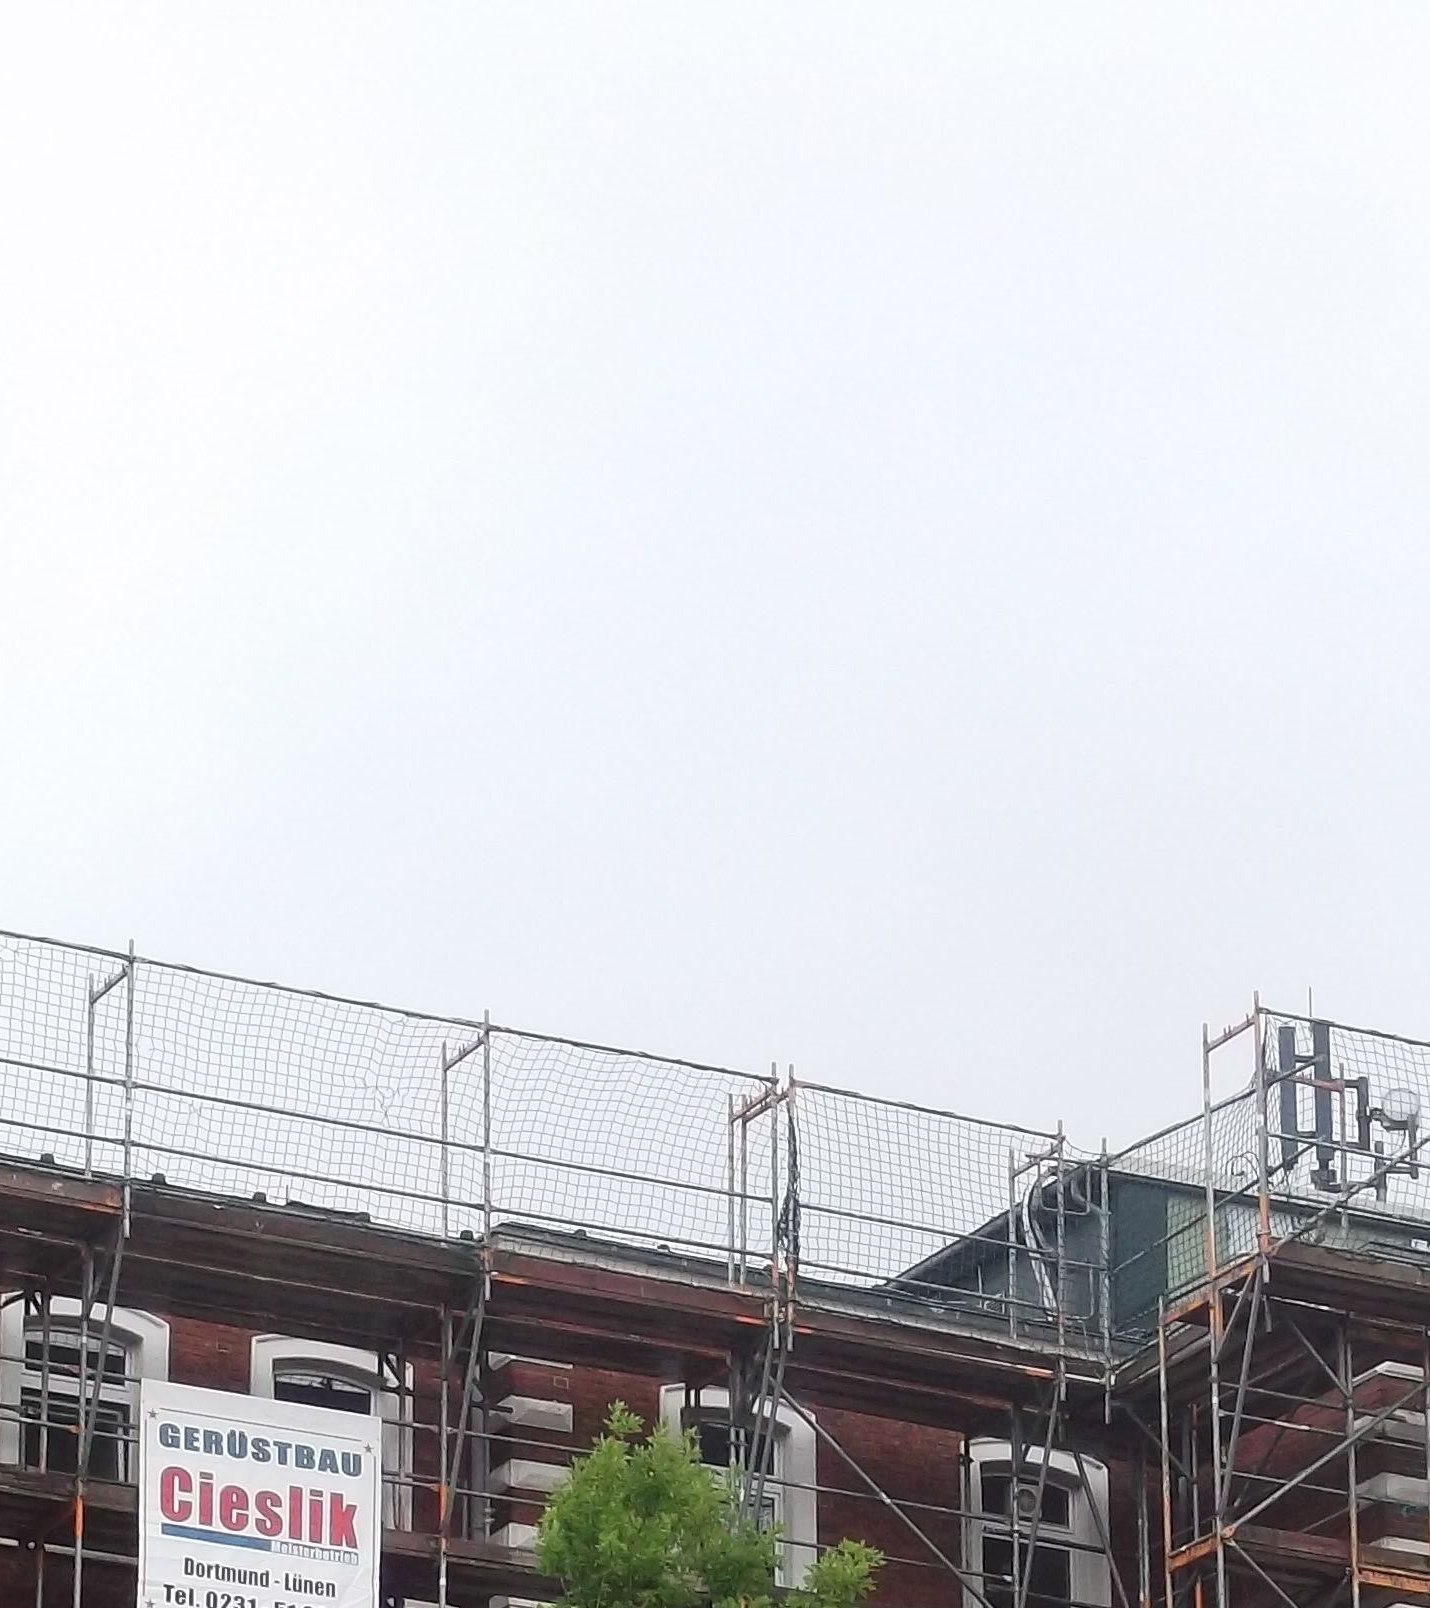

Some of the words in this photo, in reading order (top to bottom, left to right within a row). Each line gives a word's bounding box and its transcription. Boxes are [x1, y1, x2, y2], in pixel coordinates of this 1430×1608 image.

[159, 1422, 362, 1477] GERÜSTBAU
[160, 1466, 358, 1549] Cieslik
[272, 1540, 359, 1565] Meisterbetrieb
[163, 1584, 201, 1608] Tel.
[184, 1557, 270, 1588] Dortmund
[284, 1573, 336, 1597] Lünen
